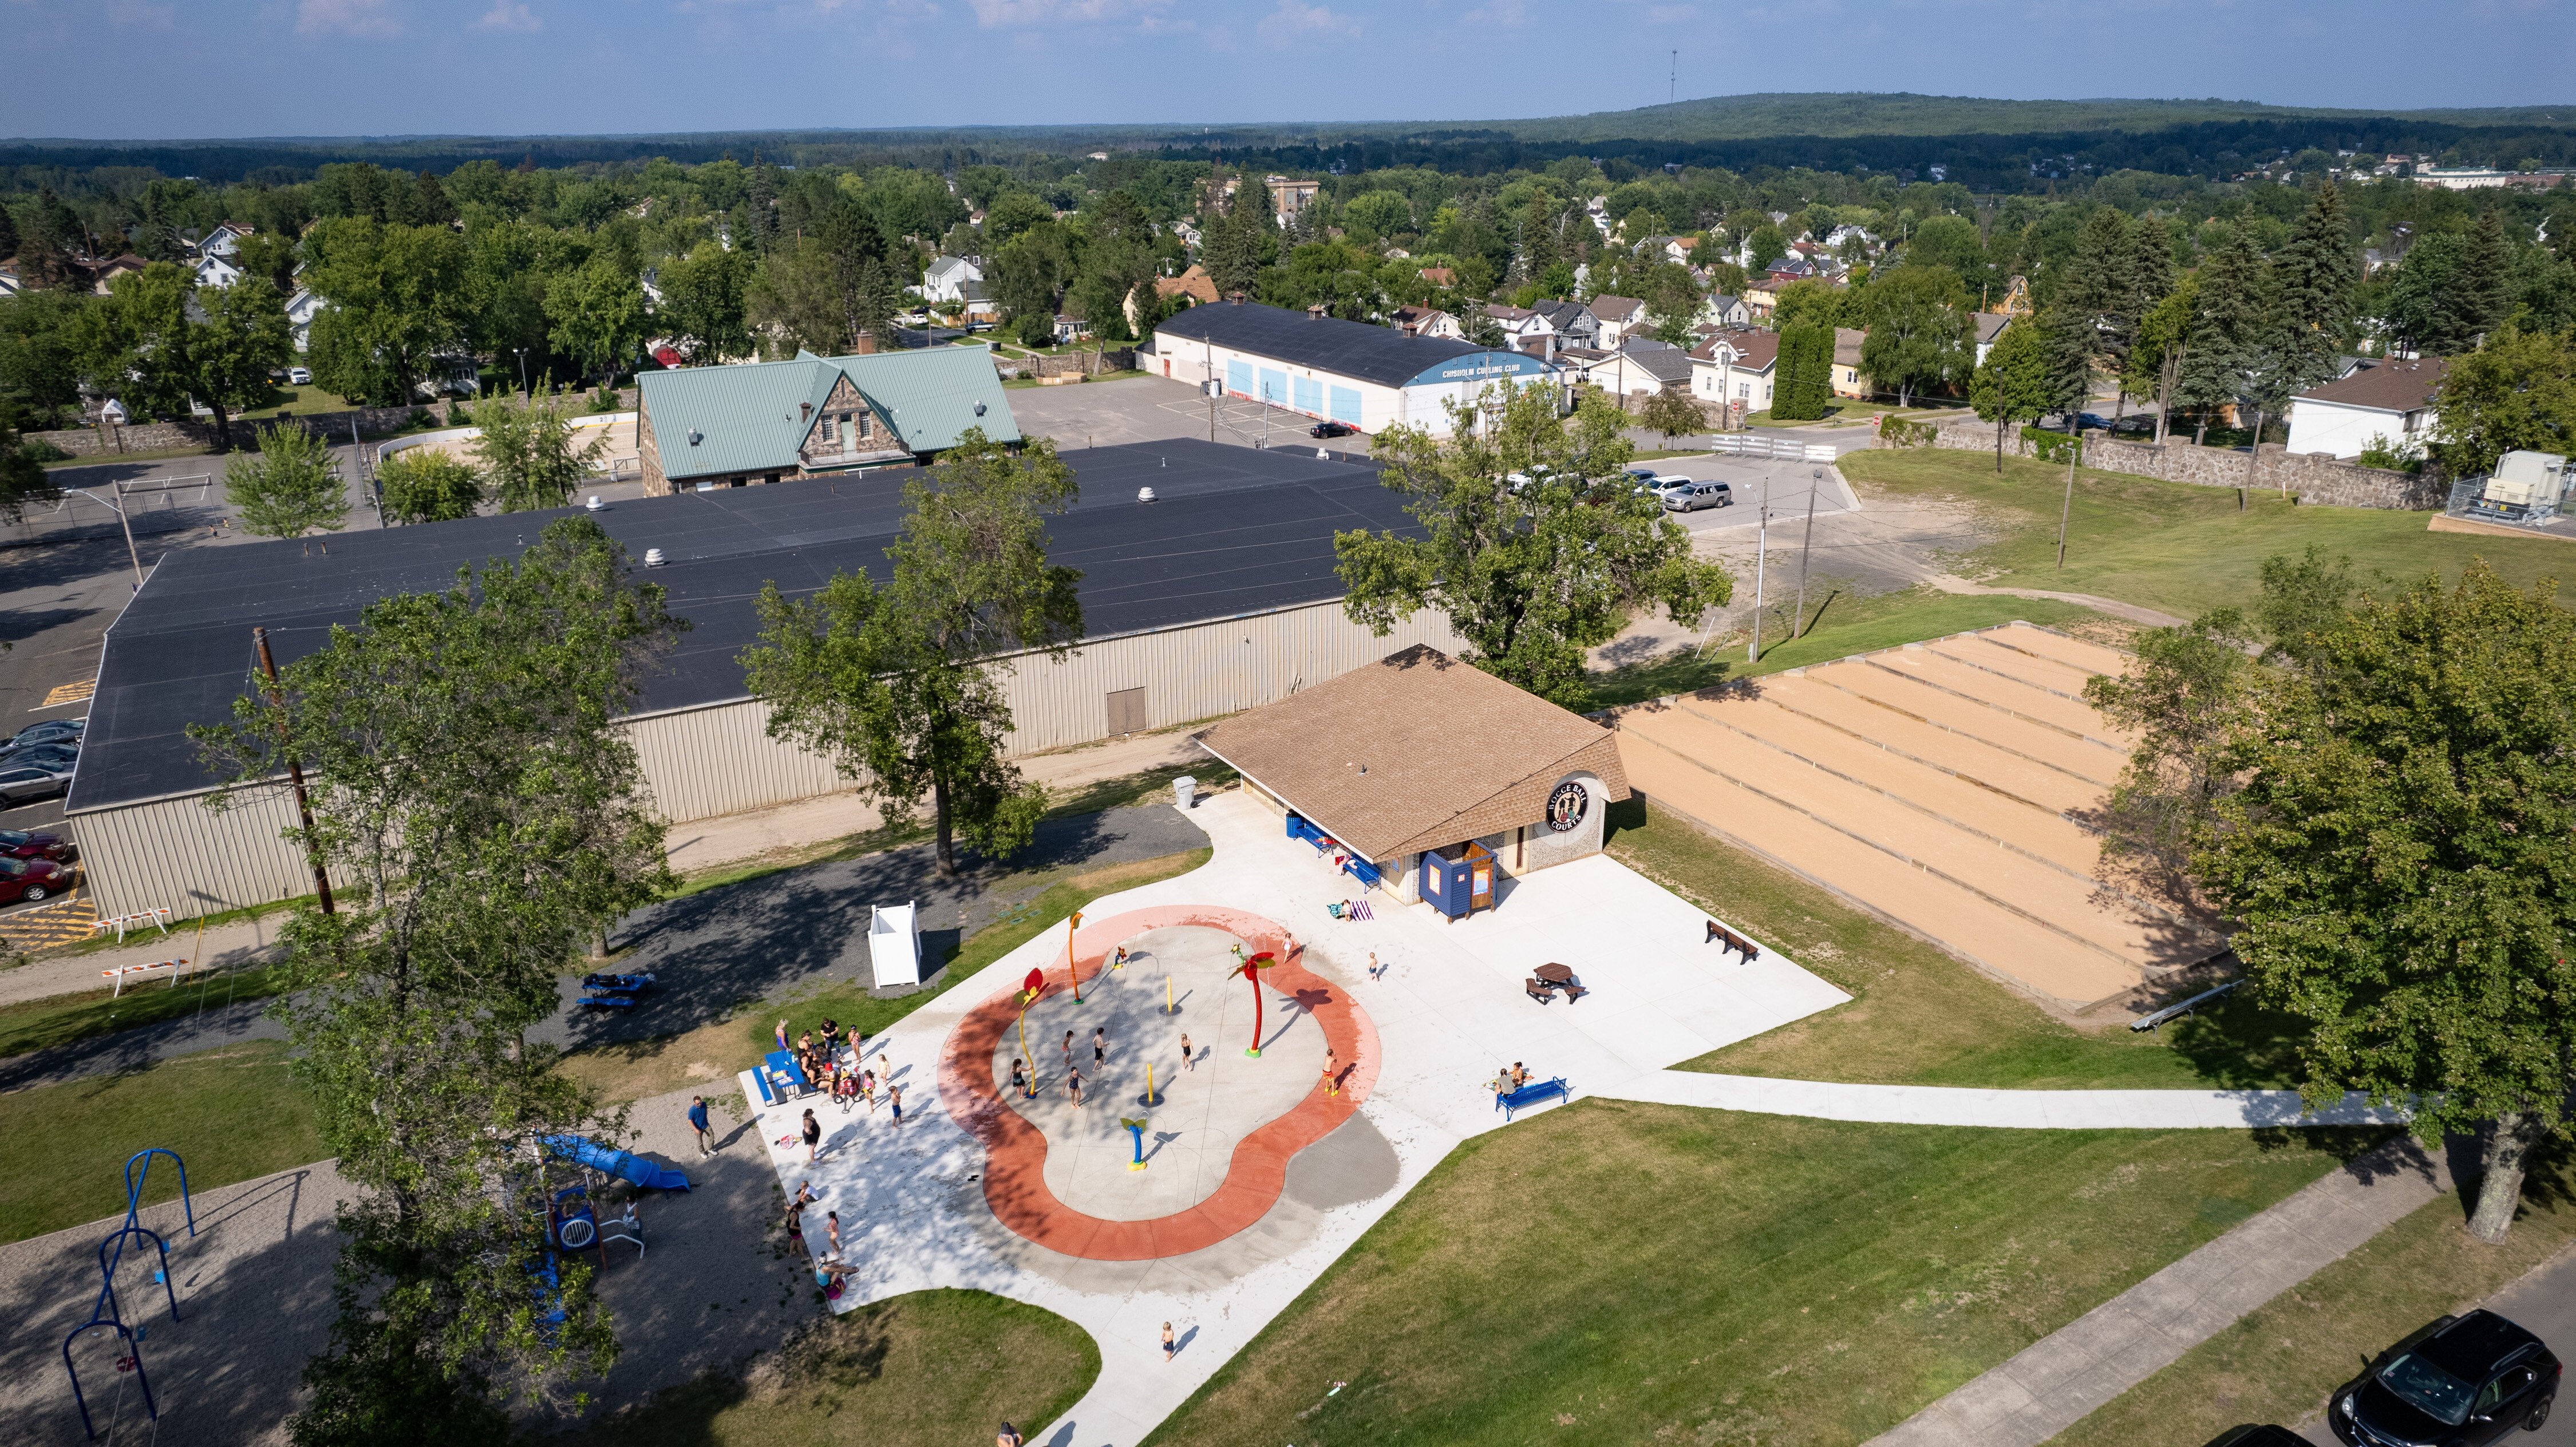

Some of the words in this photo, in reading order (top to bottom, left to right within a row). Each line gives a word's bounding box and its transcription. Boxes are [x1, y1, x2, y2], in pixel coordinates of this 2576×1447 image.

[1443, 368, 1474, 378] CHISHOLM
[1548, 785, 1571, 809] BOCCE
[1573, 785, 1586, 803] BALL
[1552, 815, 1581, 831] COURTS
